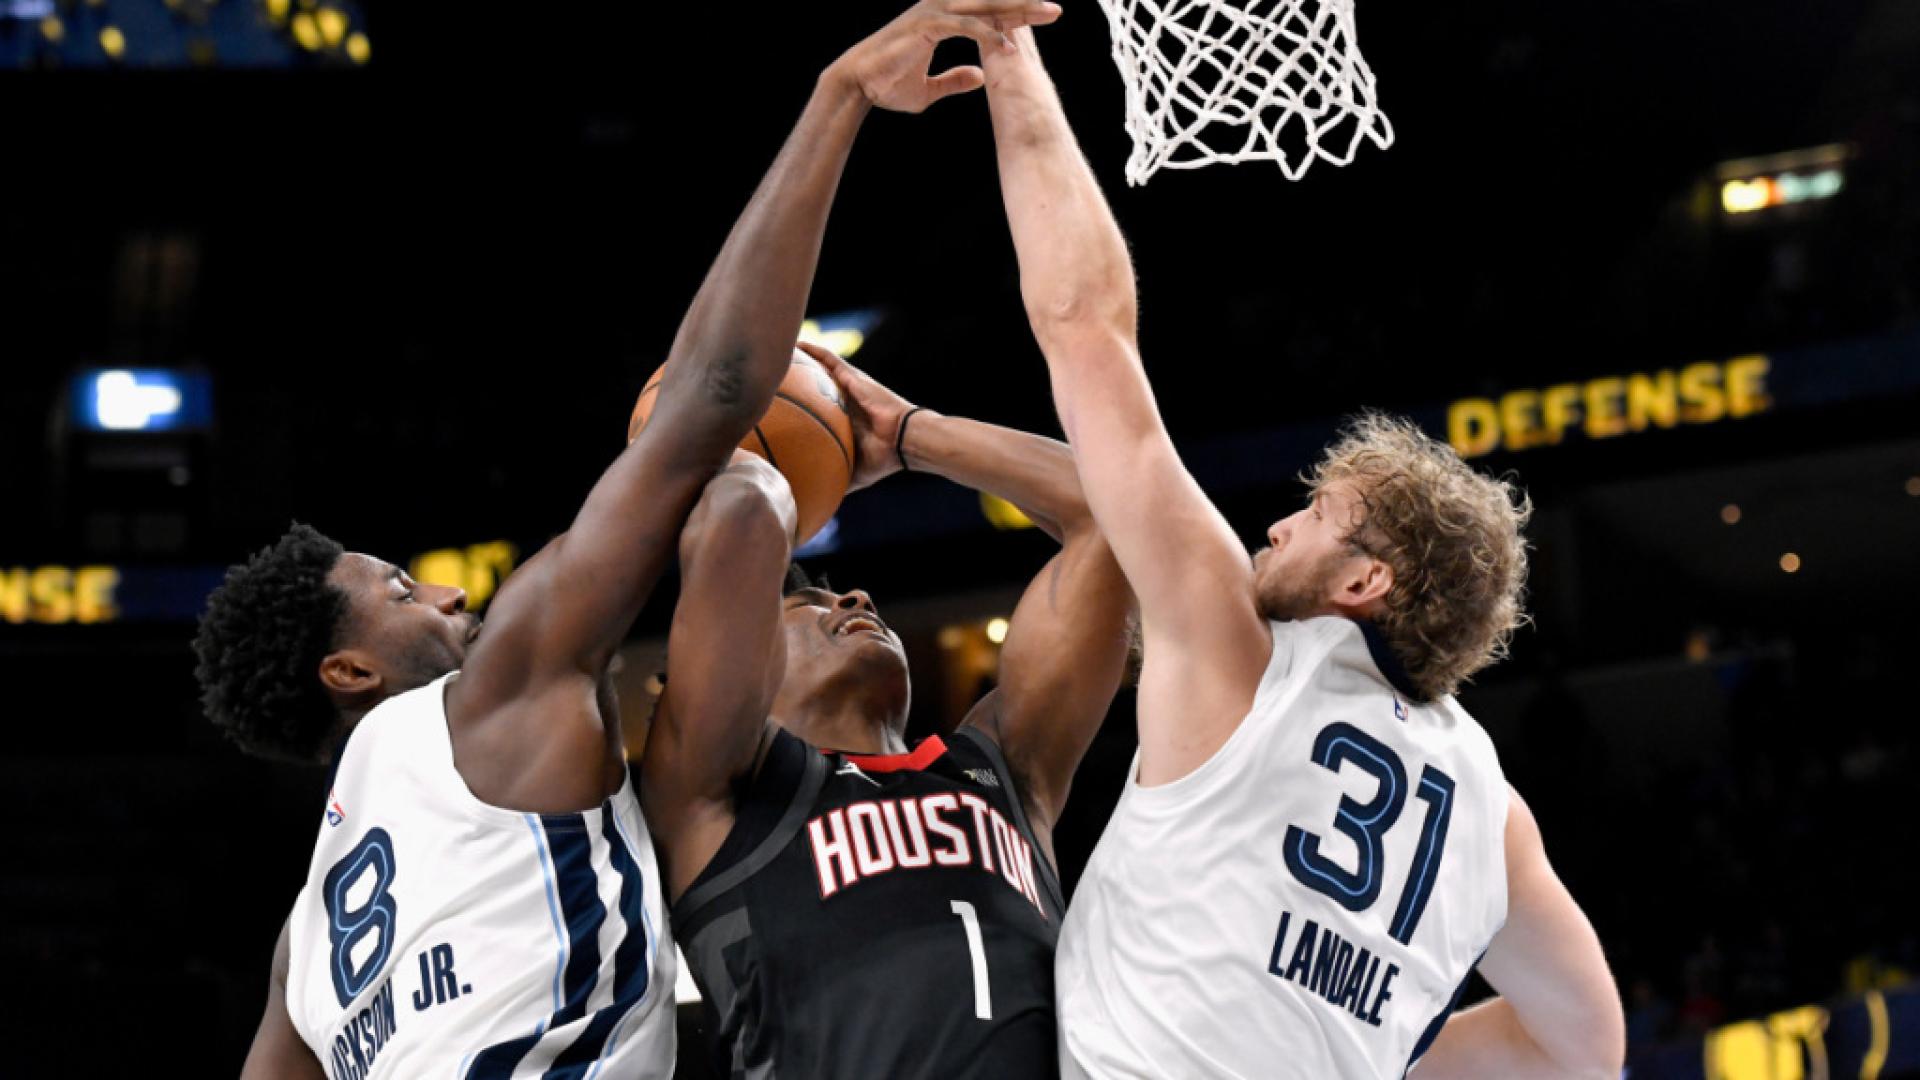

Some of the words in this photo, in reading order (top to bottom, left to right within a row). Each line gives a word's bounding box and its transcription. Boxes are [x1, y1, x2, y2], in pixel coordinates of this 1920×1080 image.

[1448, 355, 1772, 457] DEFENSE
[807, 792, 1048, 919] HOUSTON
[1282, 722, 1456, 946] 31
[323, 826, 396, 1009] 8
[950, 900, 993, 1020] 1
[1268, 911, 1400, 1027] LANDALE
[331, 976, 396, 1080] CKSON
[412, 943, 472, 1011] JR.
